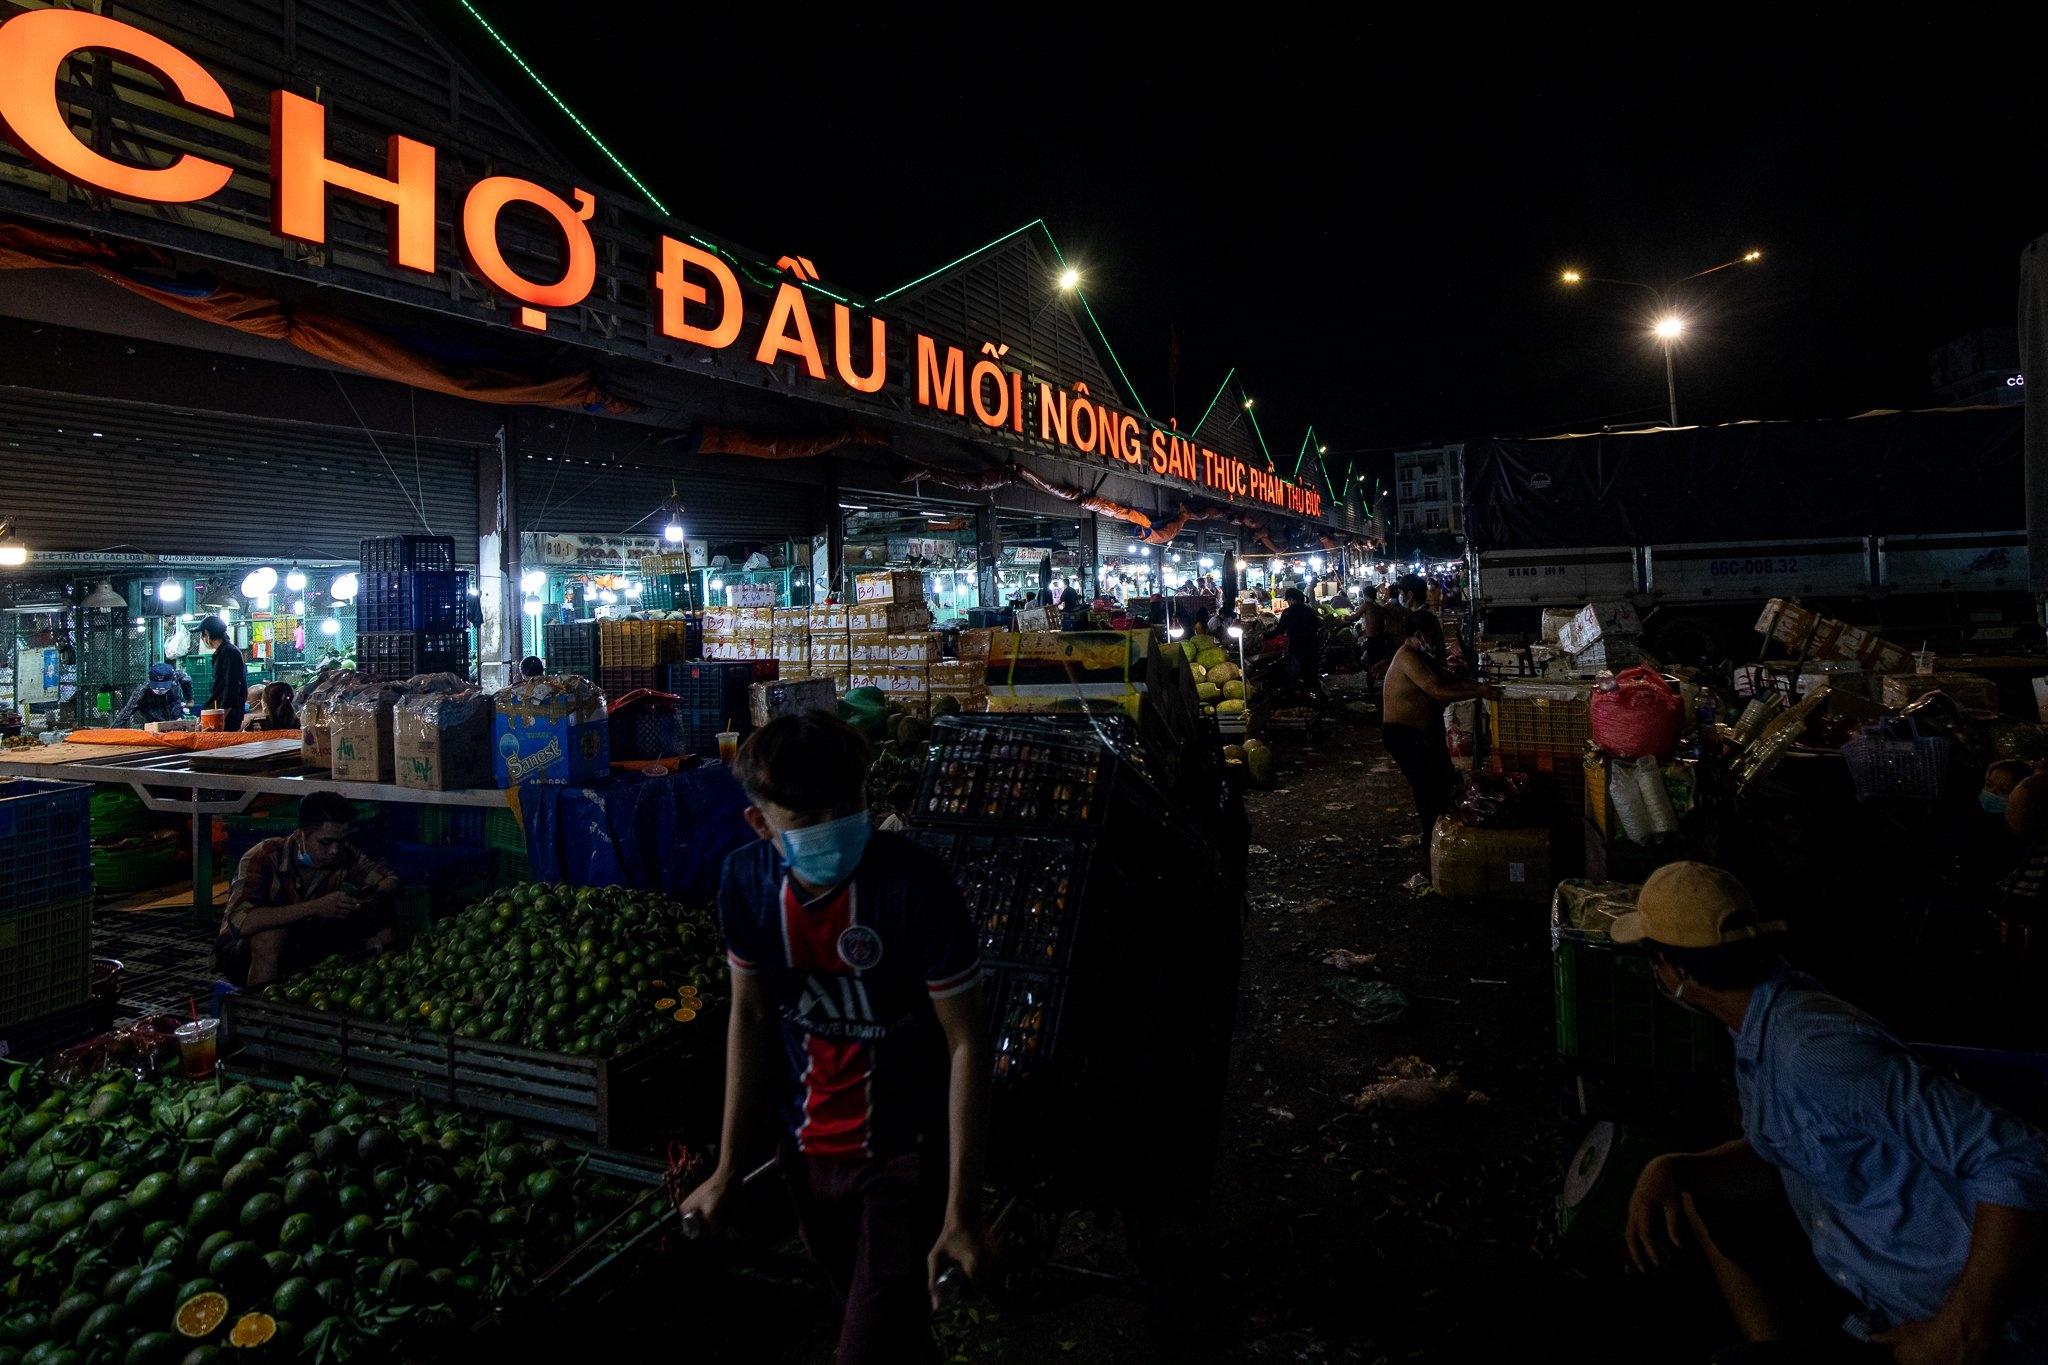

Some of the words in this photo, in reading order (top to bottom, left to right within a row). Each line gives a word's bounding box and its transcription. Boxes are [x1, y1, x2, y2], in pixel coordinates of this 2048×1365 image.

[0, 7, 596, 331] CHỢ
[656, 235, 886, 393] ĐẦU
[917, 334, 1022, 432] MỐI
[1040, 382, 1142, 464] NÔNG
[1152, 417, 1197, 480] SẢN
[1202, 449, 1246, 500] THỰC
[1249, 461, 1284, 506] PHẨM
[1711, 558, 1798, 576] 66C-008.32
[857, 585, 885, 597] B9.1
[506, 736, 562, 778] Sanest
